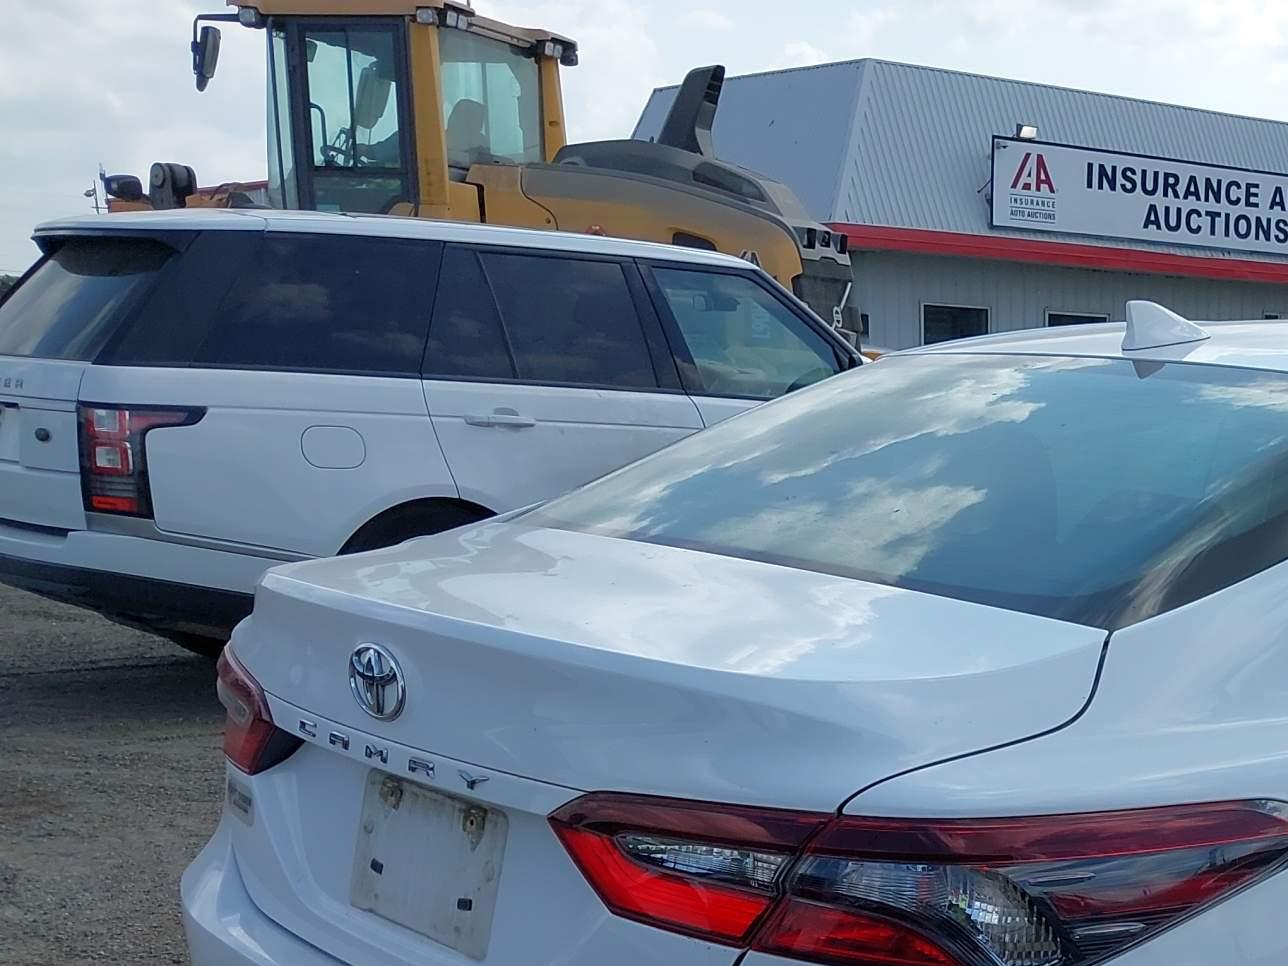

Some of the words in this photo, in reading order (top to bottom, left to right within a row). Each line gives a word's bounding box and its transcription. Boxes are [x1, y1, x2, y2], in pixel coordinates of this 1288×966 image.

[1086, 162, 1260, 209] INSURANCE
[1009, 196, 1056, 209] INSURANCE
[1009, 209, 1026, 218] AUTO
[1027, 210, 1056, 221] AUCTIONS
[298, 719, 490, 791] CAMRY
